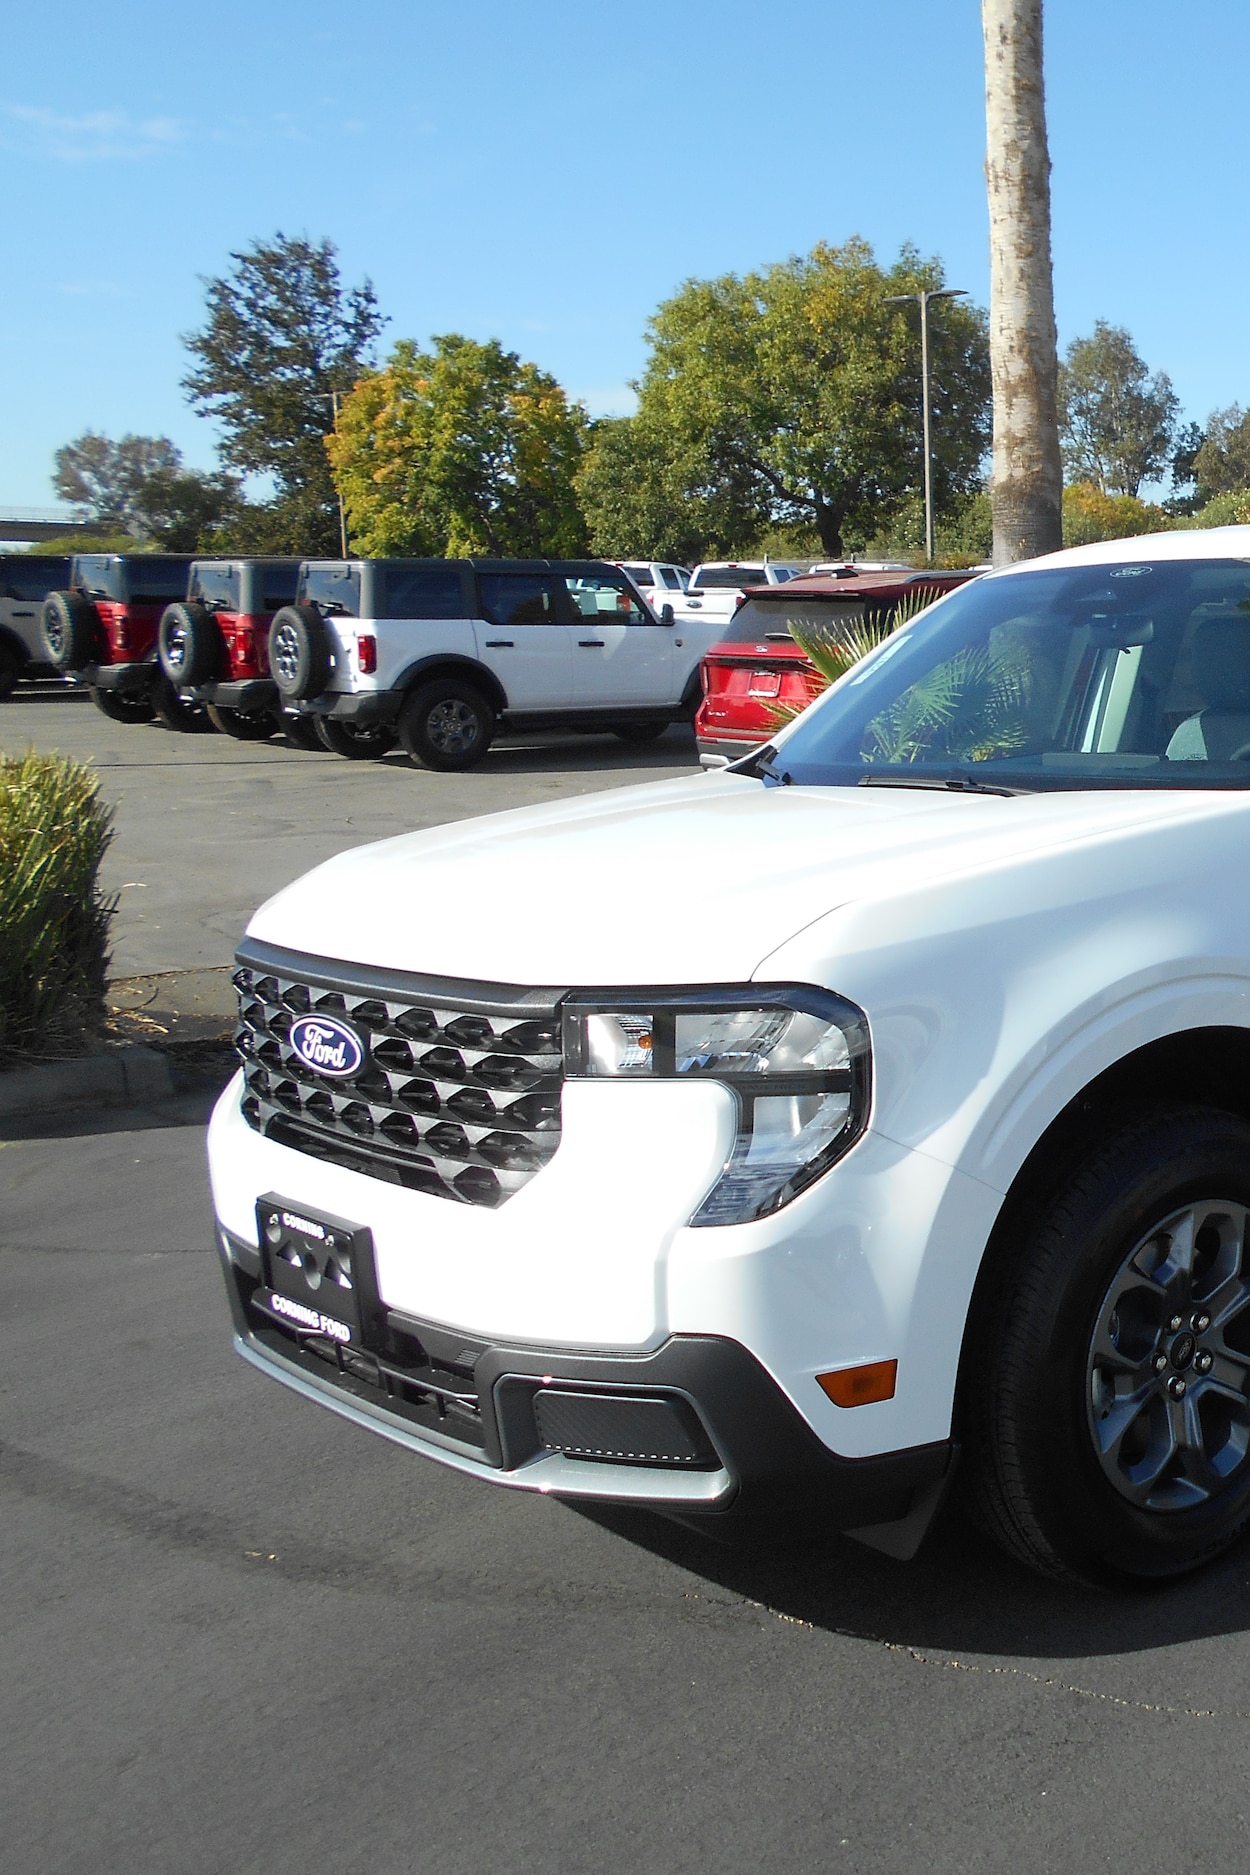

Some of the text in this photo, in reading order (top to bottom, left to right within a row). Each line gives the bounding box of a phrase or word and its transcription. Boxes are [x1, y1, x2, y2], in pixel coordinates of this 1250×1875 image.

[302, 1023, 346, 1068] Ford
[282, 1212, 326, 1240] CORNING
[271, 1293, 351, 1342] CORNING FORD
